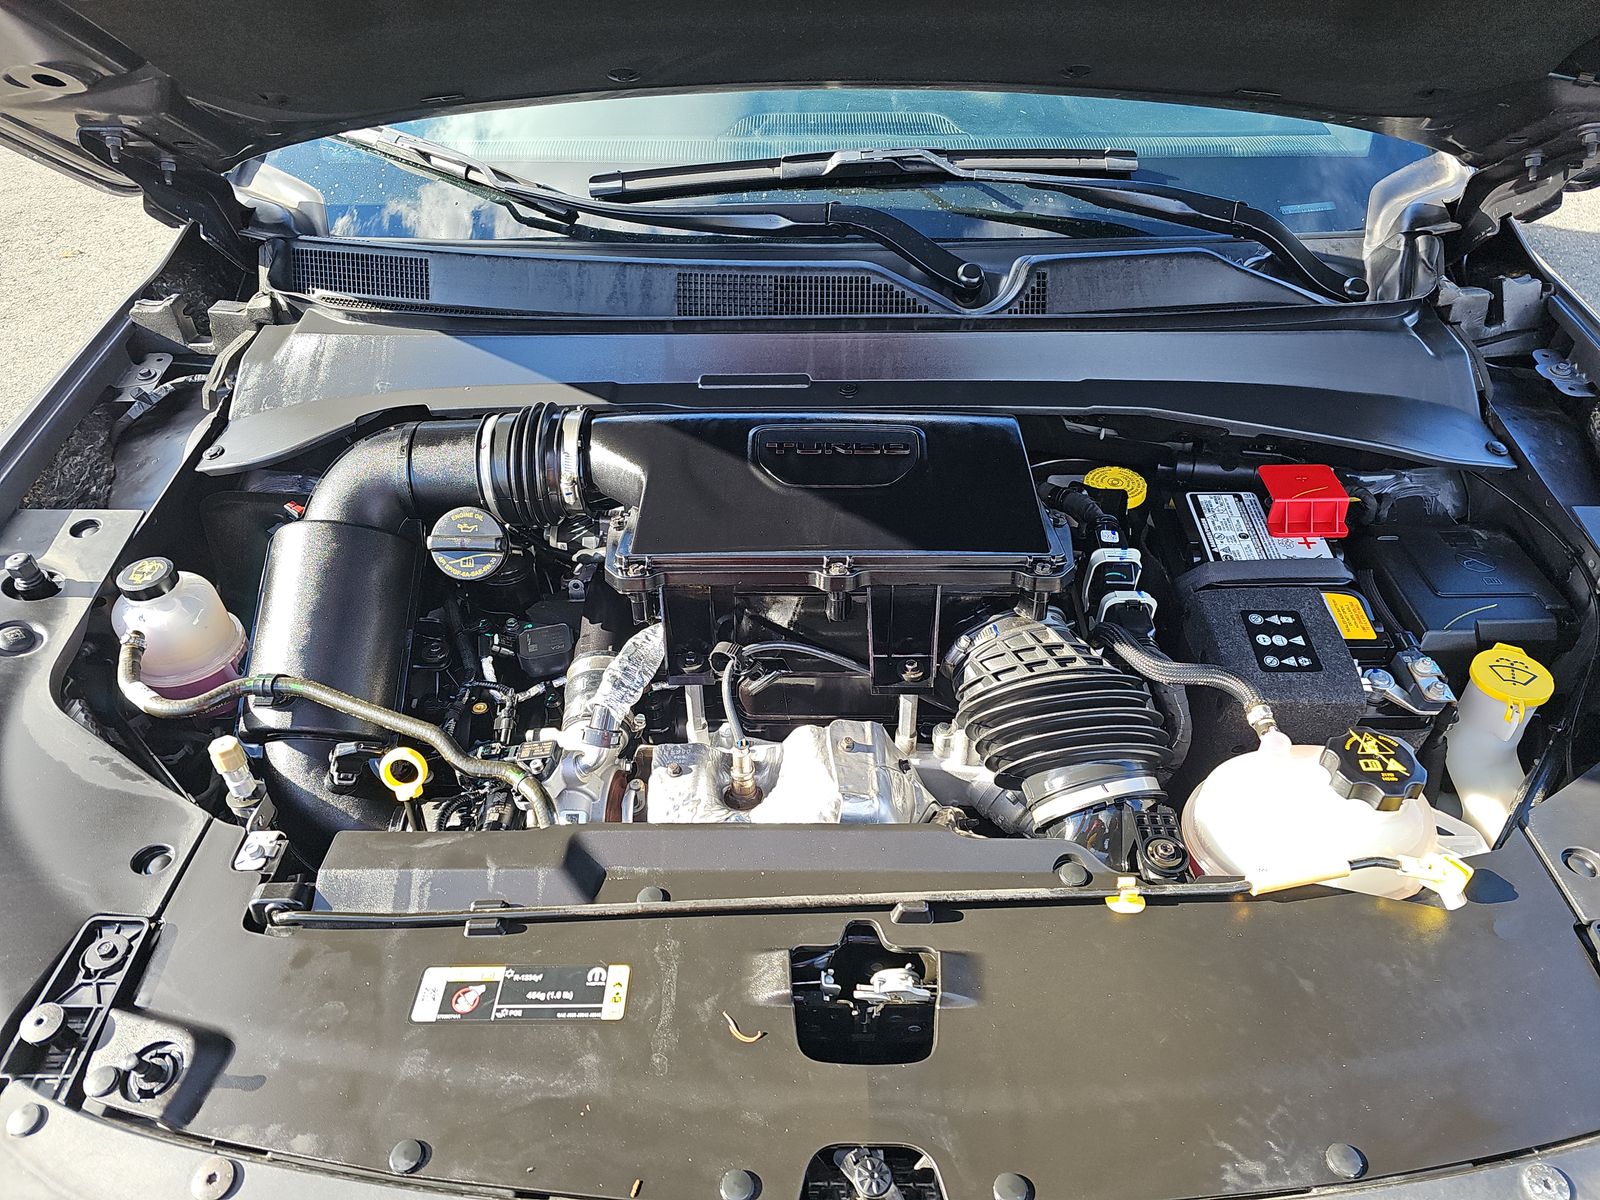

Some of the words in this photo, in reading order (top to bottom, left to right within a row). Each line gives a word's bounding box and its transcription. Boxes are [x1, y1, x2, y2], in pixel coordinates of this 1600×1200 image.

[765, 441, 911, 456] TURBO
[451, 511, 474, 521] ENGINE
[474, 513, 484, 522] OIL
